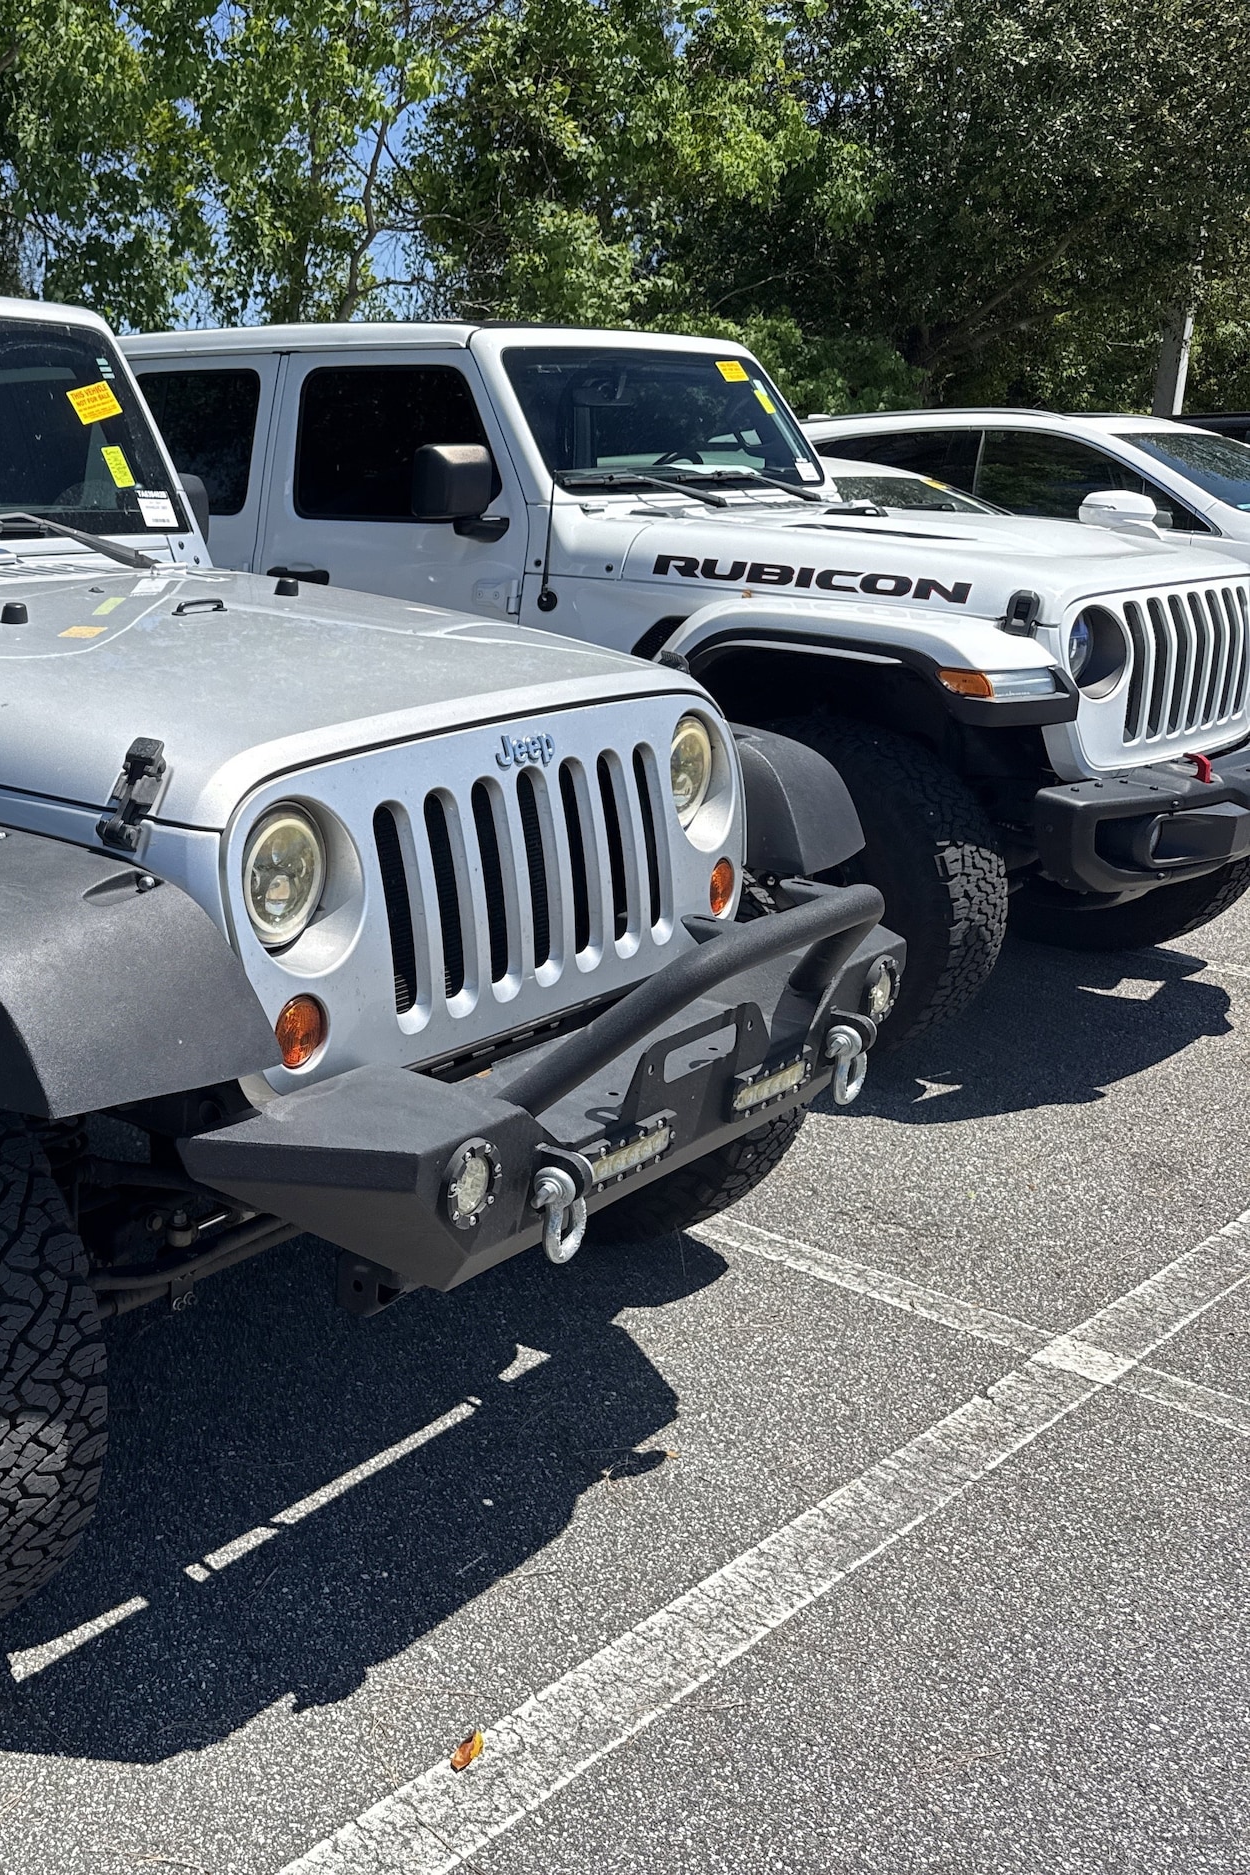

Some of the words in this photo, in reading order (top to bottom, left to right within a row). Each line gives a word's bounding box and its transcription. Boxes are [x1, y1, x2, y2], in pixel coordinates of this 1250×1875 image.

[70, 389, 85, 401] THIS
[76, 399, 87, 408] NOT
[87, 396, 99, 405] FOR
[652, 554, 973, 605] RUBICON
[495, 733, 555, 768] Jeep
